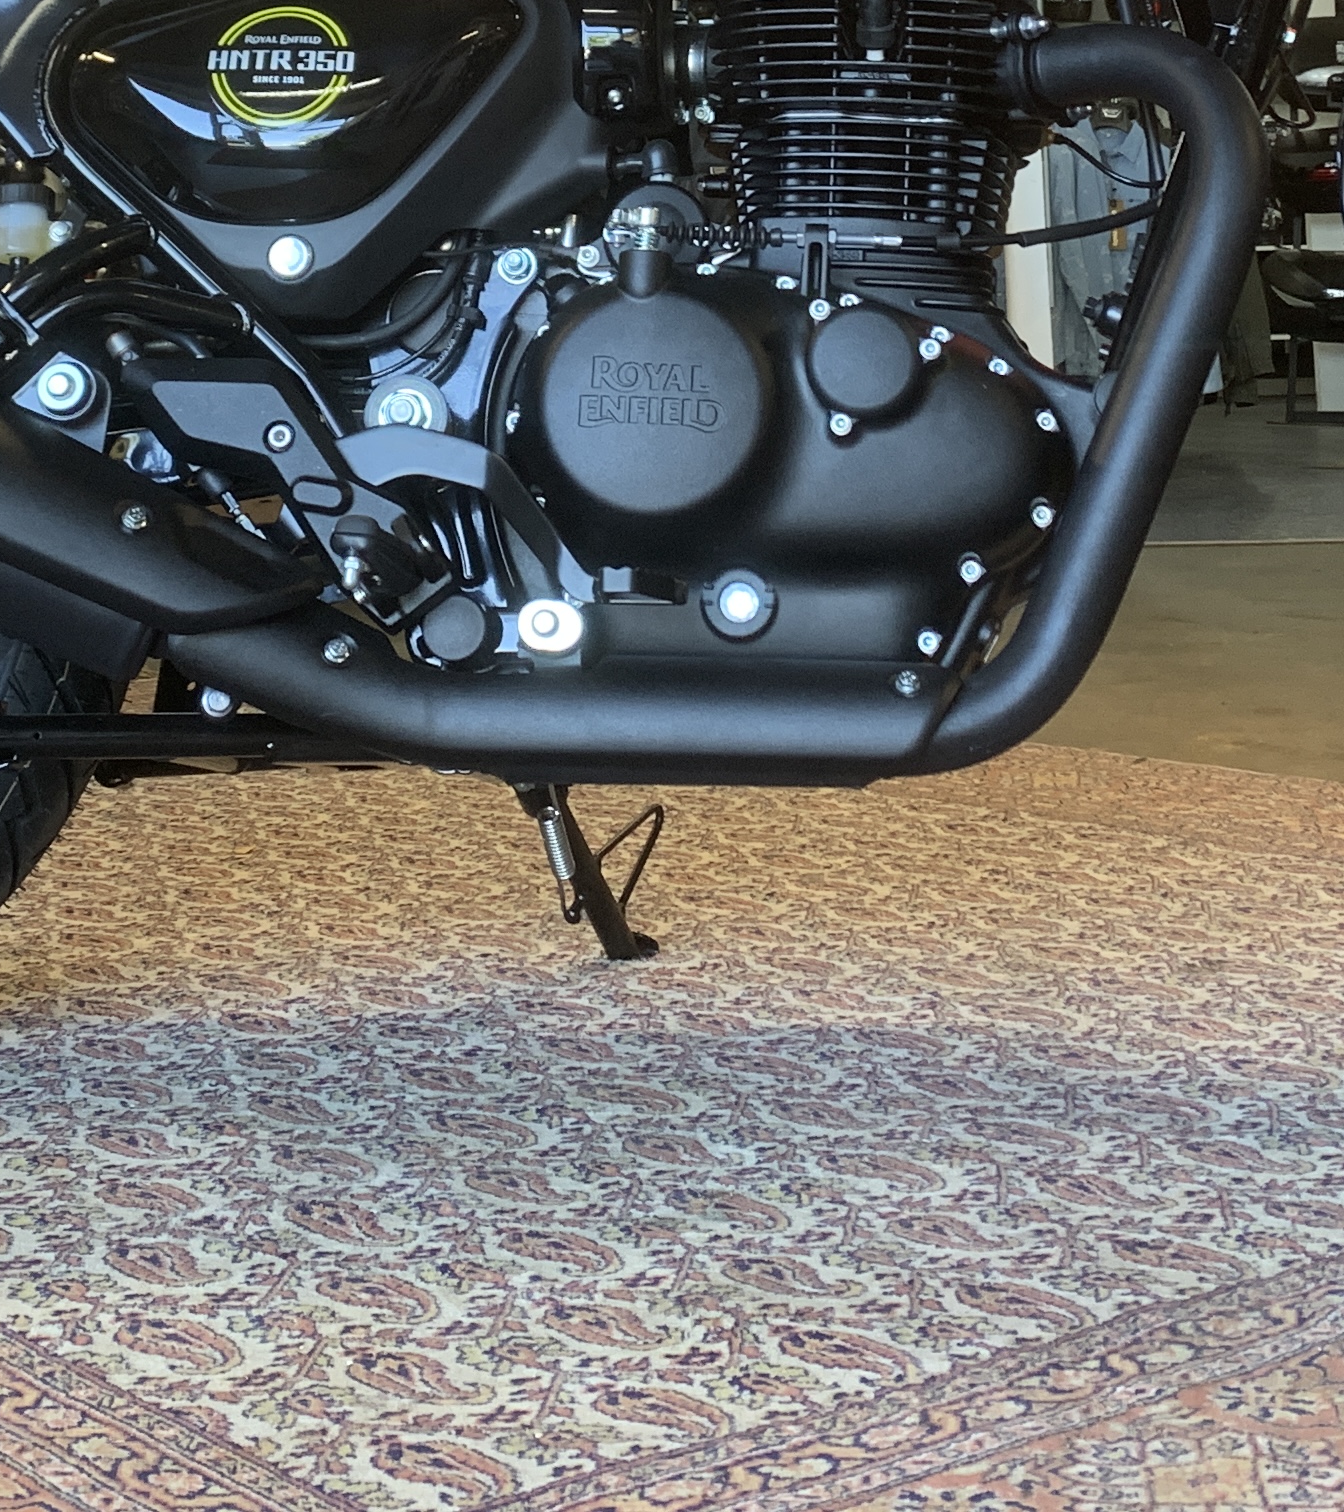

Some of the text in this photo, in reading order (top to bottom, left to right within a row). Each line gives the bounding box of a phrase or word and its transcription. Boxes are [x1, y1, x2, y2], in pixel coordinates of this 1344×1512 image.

[244, 34, 323, 45] ROYAL ENFIELD
[207, 50, 356, 73] HNTR 350
[252, 75, 305, 84] SINCE 1901
[590, 354, 710, 394] ROYAL
[577, 394, 728, 434] ENFIELD
